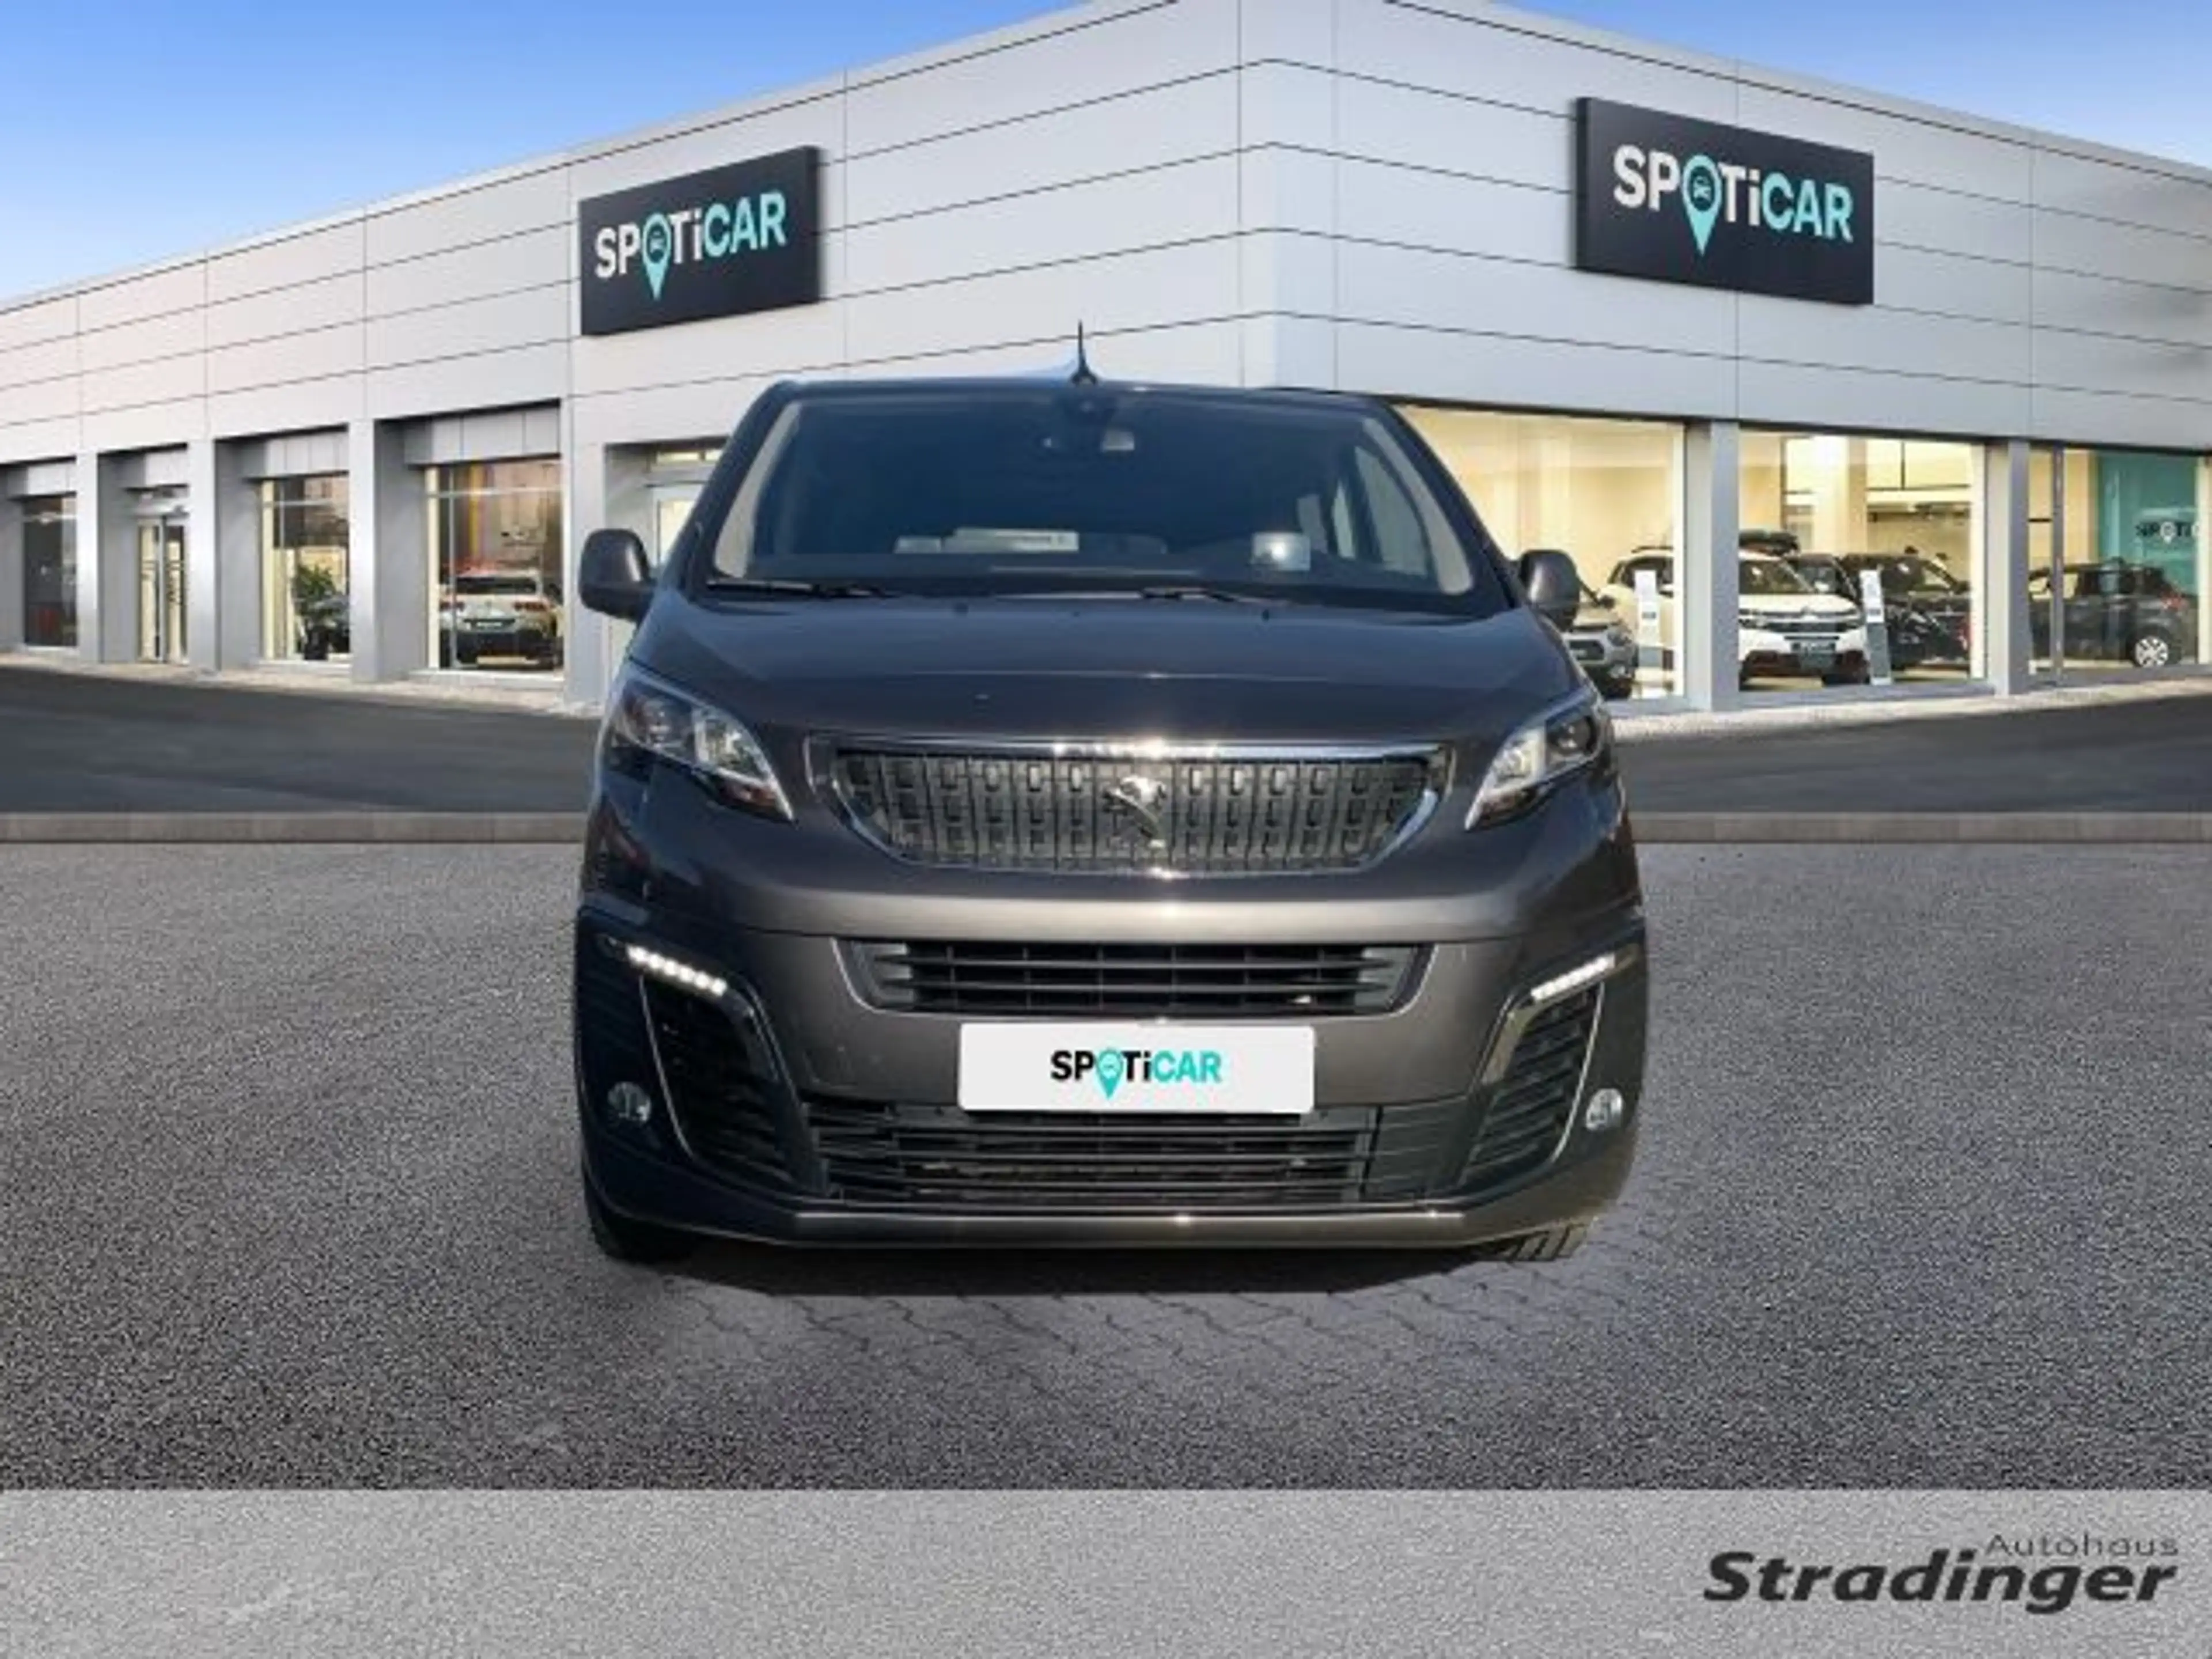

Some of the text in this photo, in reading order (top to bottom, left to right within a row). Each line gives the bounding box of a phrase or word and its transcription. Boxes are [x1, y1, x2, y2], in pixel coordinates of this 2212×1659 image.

[594, 190, 787, 301] SPOTiCAR
[1613, 144, 1854, 255] SPOTiCAR
[1050, 1048, 1222, 1100] SPOTiCAR
